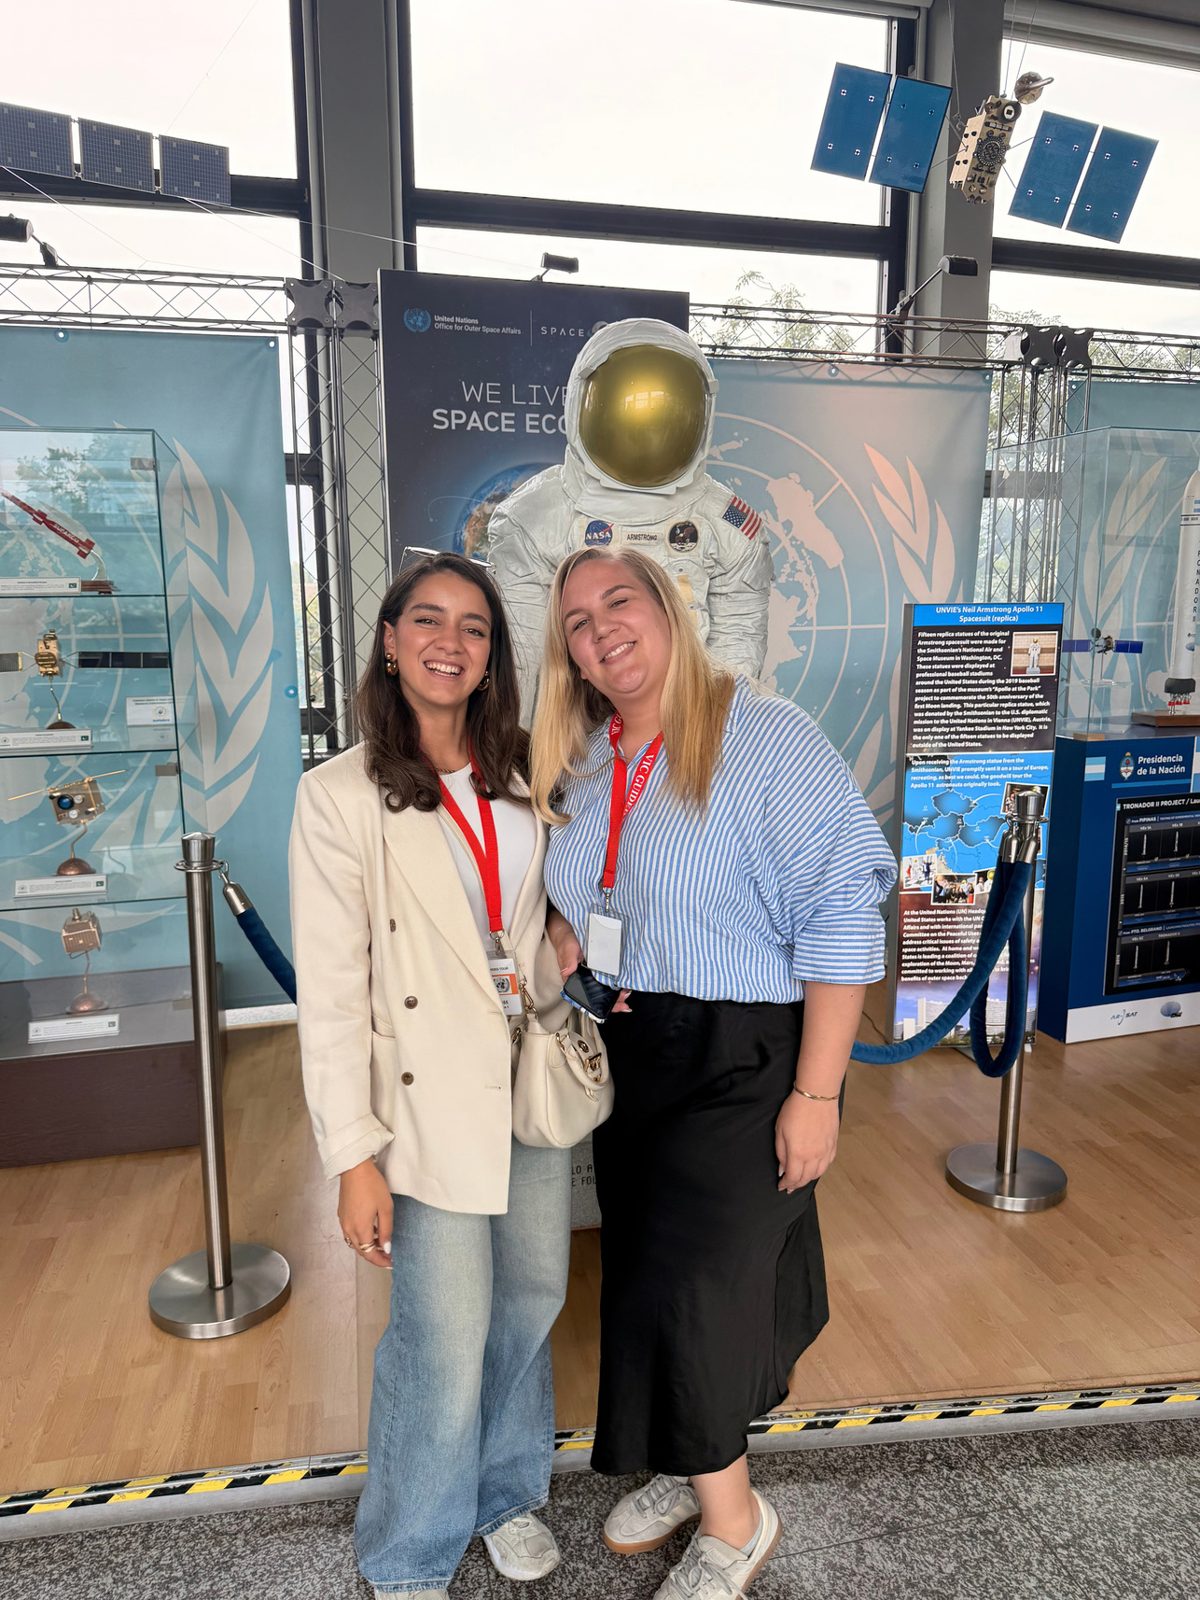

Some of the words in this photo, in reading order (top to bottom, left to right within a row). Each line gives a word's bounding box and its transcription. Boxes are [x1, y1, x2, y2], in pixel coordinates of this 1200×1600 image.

[540, 326, 584, 337] SPACE
[462, 381, 501, 403] WE
[432, 408, 515, 432] SPACE
[586, 530, 611, 540] NASA
[640, 754, 654, 774] VIC
[1138, 754, 1183, 764] Presidencia
[1137, 767, 1147, 775] de
[1159, 765, 1185, 774] Nación
